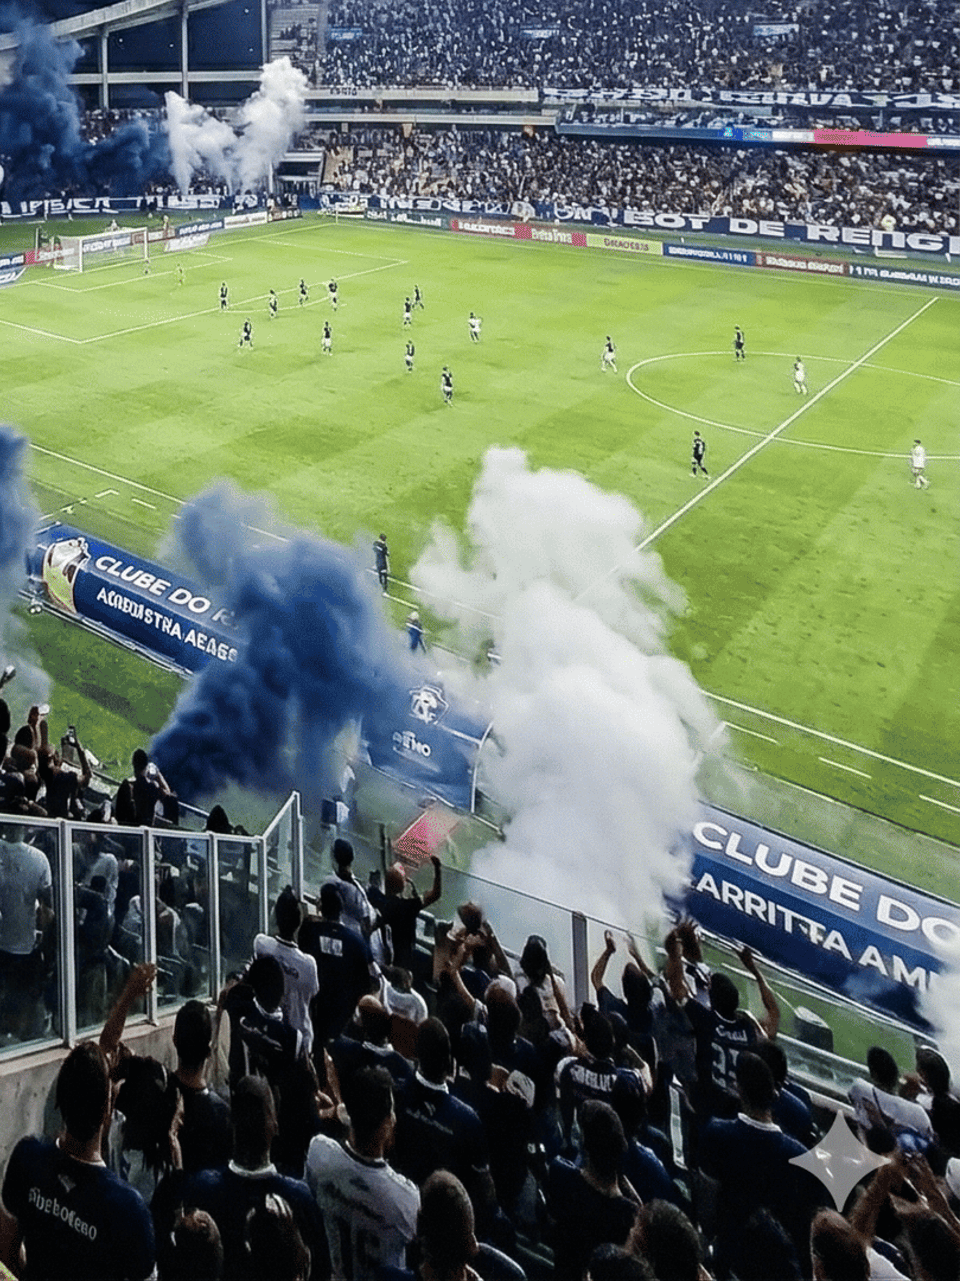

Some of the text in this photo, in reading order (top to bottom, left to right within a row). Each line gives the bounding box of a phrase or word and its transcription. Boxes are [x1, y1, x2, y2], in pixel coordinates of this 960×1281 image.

[729, 218, 785, 237] DE
[95, 556, 211, 613] CLUBE DO
[693, 821, 960, 952] CLUBE DO
